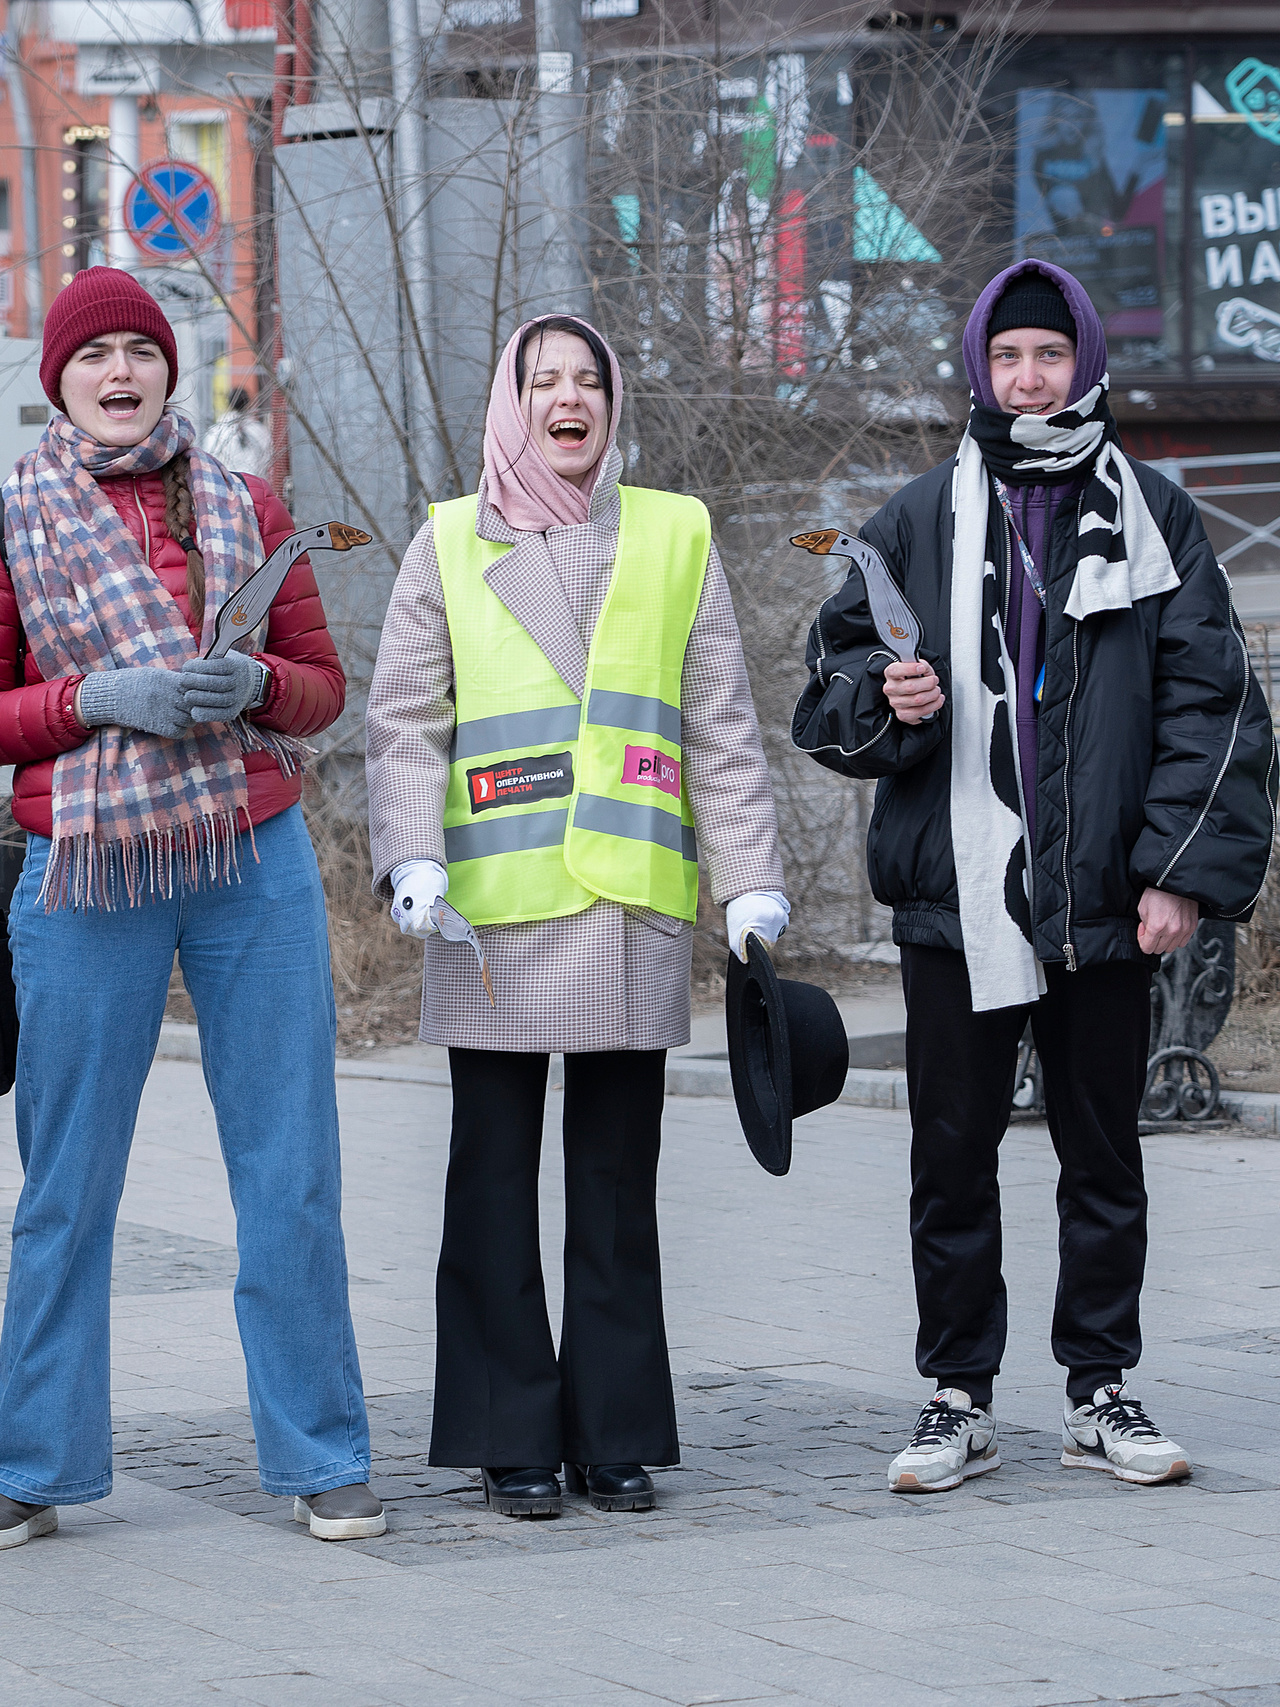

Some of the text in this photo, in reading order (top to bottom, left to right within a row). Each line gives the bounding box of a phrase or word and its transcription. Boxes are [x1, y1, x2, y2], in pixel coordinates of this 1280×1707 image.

[1200, 187, 1280, 239] ВЫ
[1205, 244, 1244, 289] И
[1249, 240, 1280, 286] А
[495, 767, 523, 779] ЦЕНТР
[496, 768, 564, 788] ОПЕРАТИВНОЙ
[497, 784, 533, 797] ПЕЧАТИ
